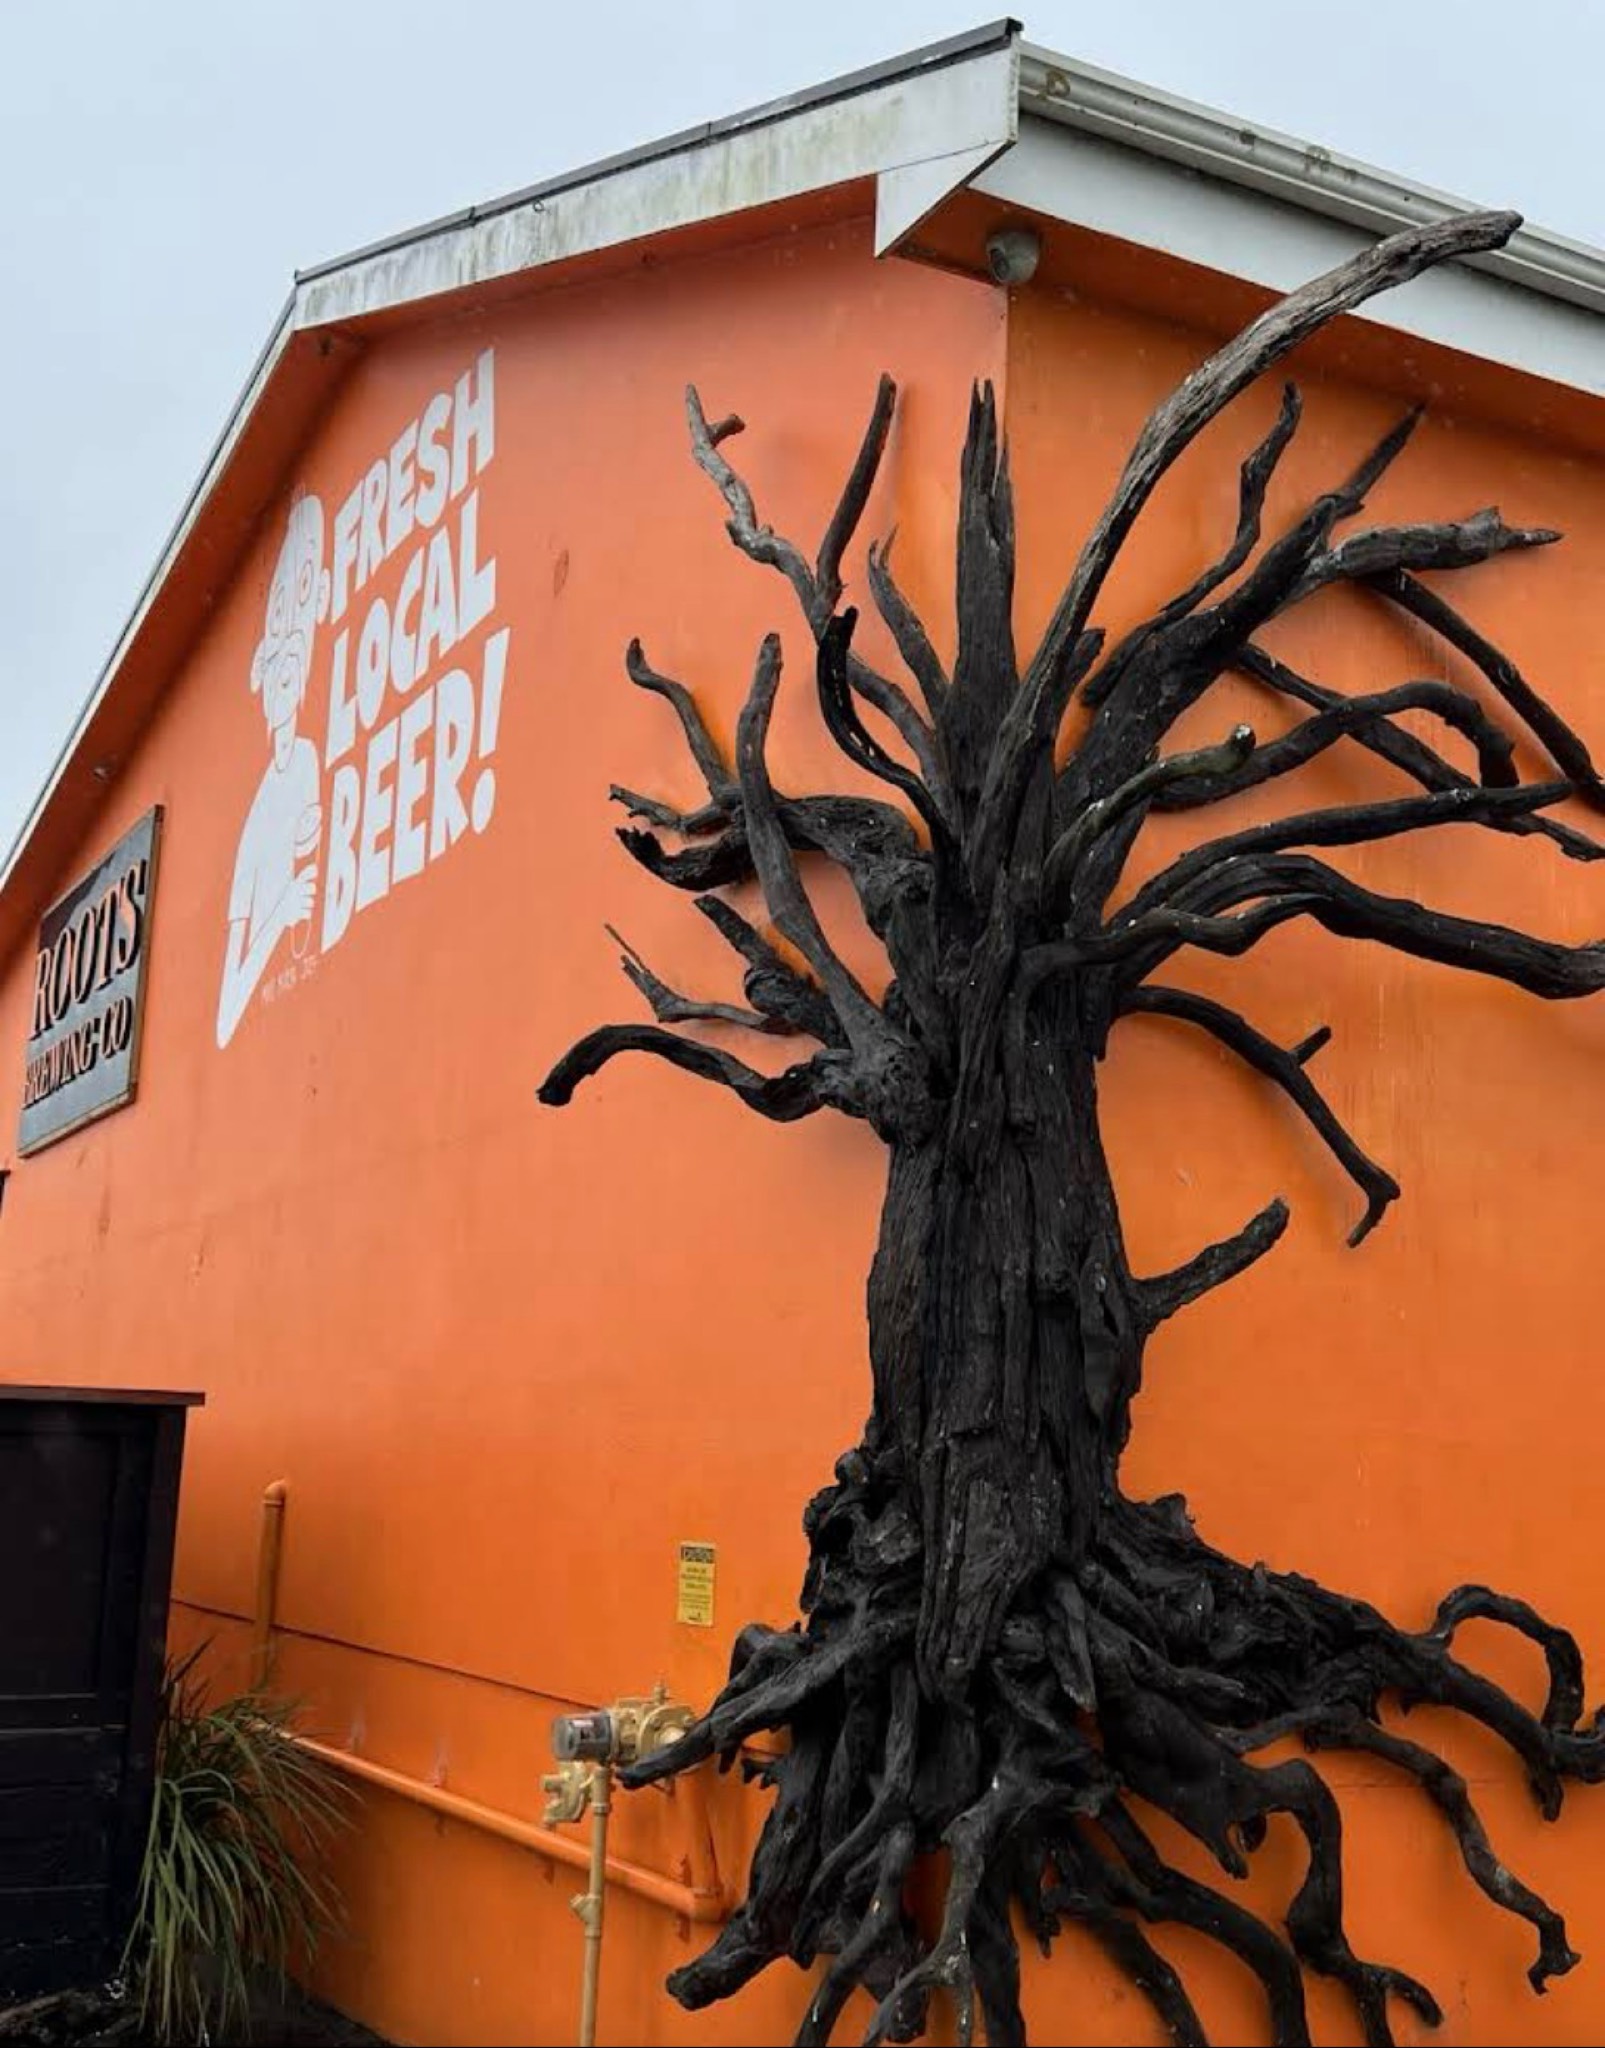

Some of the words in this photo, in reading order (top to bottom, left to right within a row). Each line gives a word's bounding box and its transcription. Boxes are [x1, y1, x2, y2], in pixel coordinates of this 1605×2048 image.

[333, 349, 495, 624] FRESH
[326, 489, 496, 768] LOCAL
[321, 629, 510, 954] BEER!
[29, 859, 147, 1041] ROOTS
[101, 996, 132, 1060] CO
